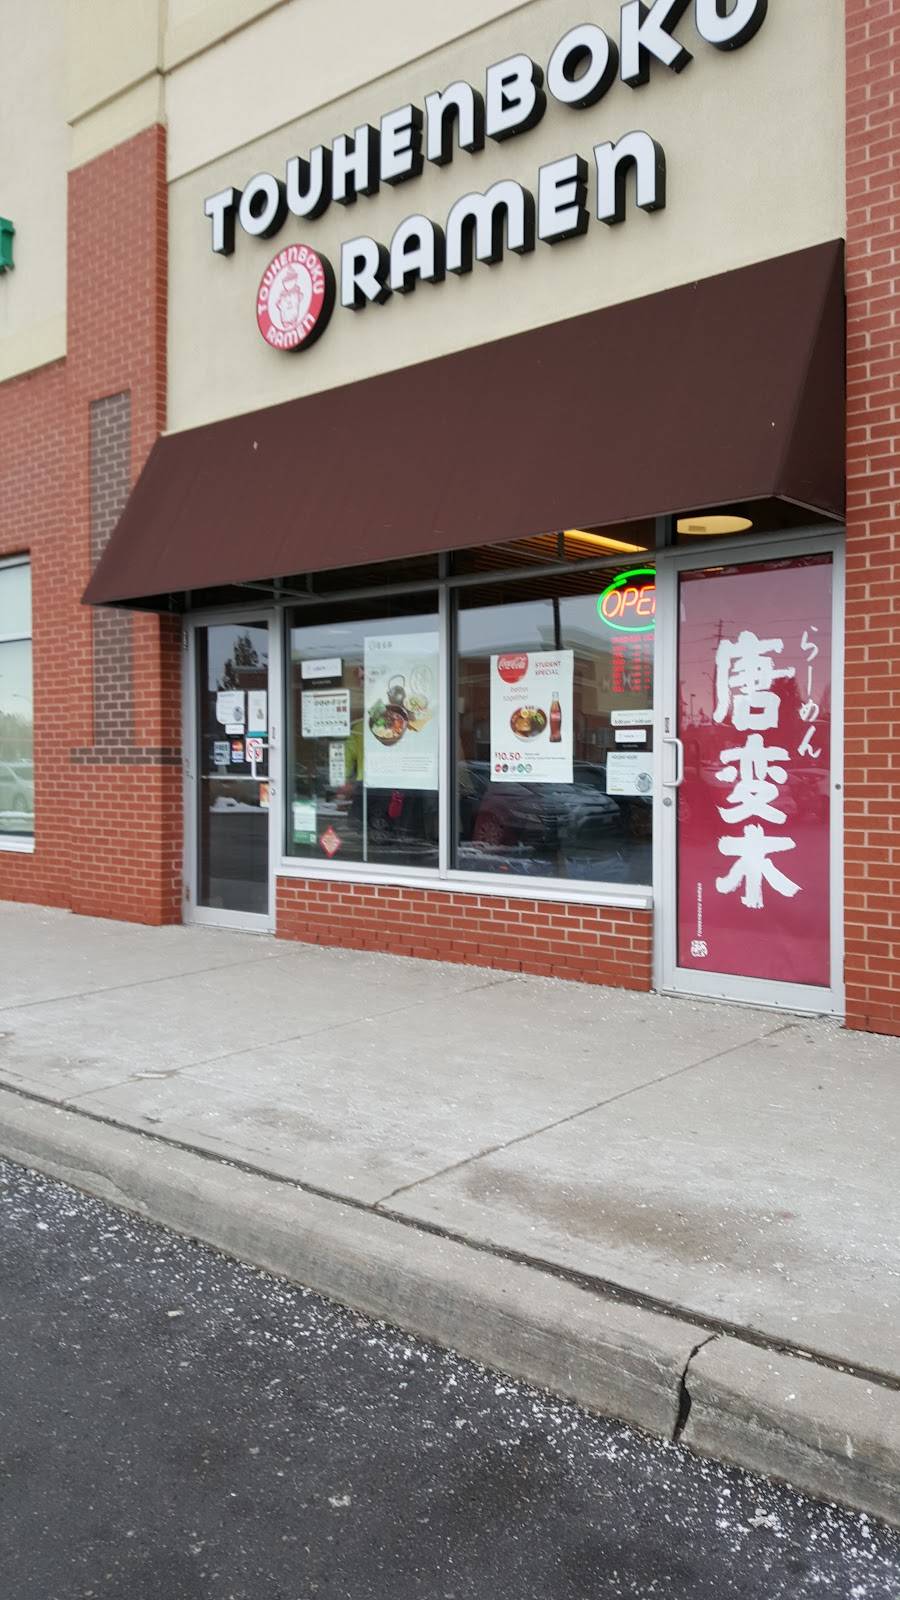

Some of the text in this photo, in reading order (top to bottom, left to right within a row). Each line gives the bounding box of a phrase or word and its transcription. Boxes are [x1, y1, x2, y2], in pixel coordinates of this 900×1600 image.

[602, 585, 656, 618] OPE
[797, 625, 822, 758] らーめん
[712, 630, 803, 909] 唐変木
